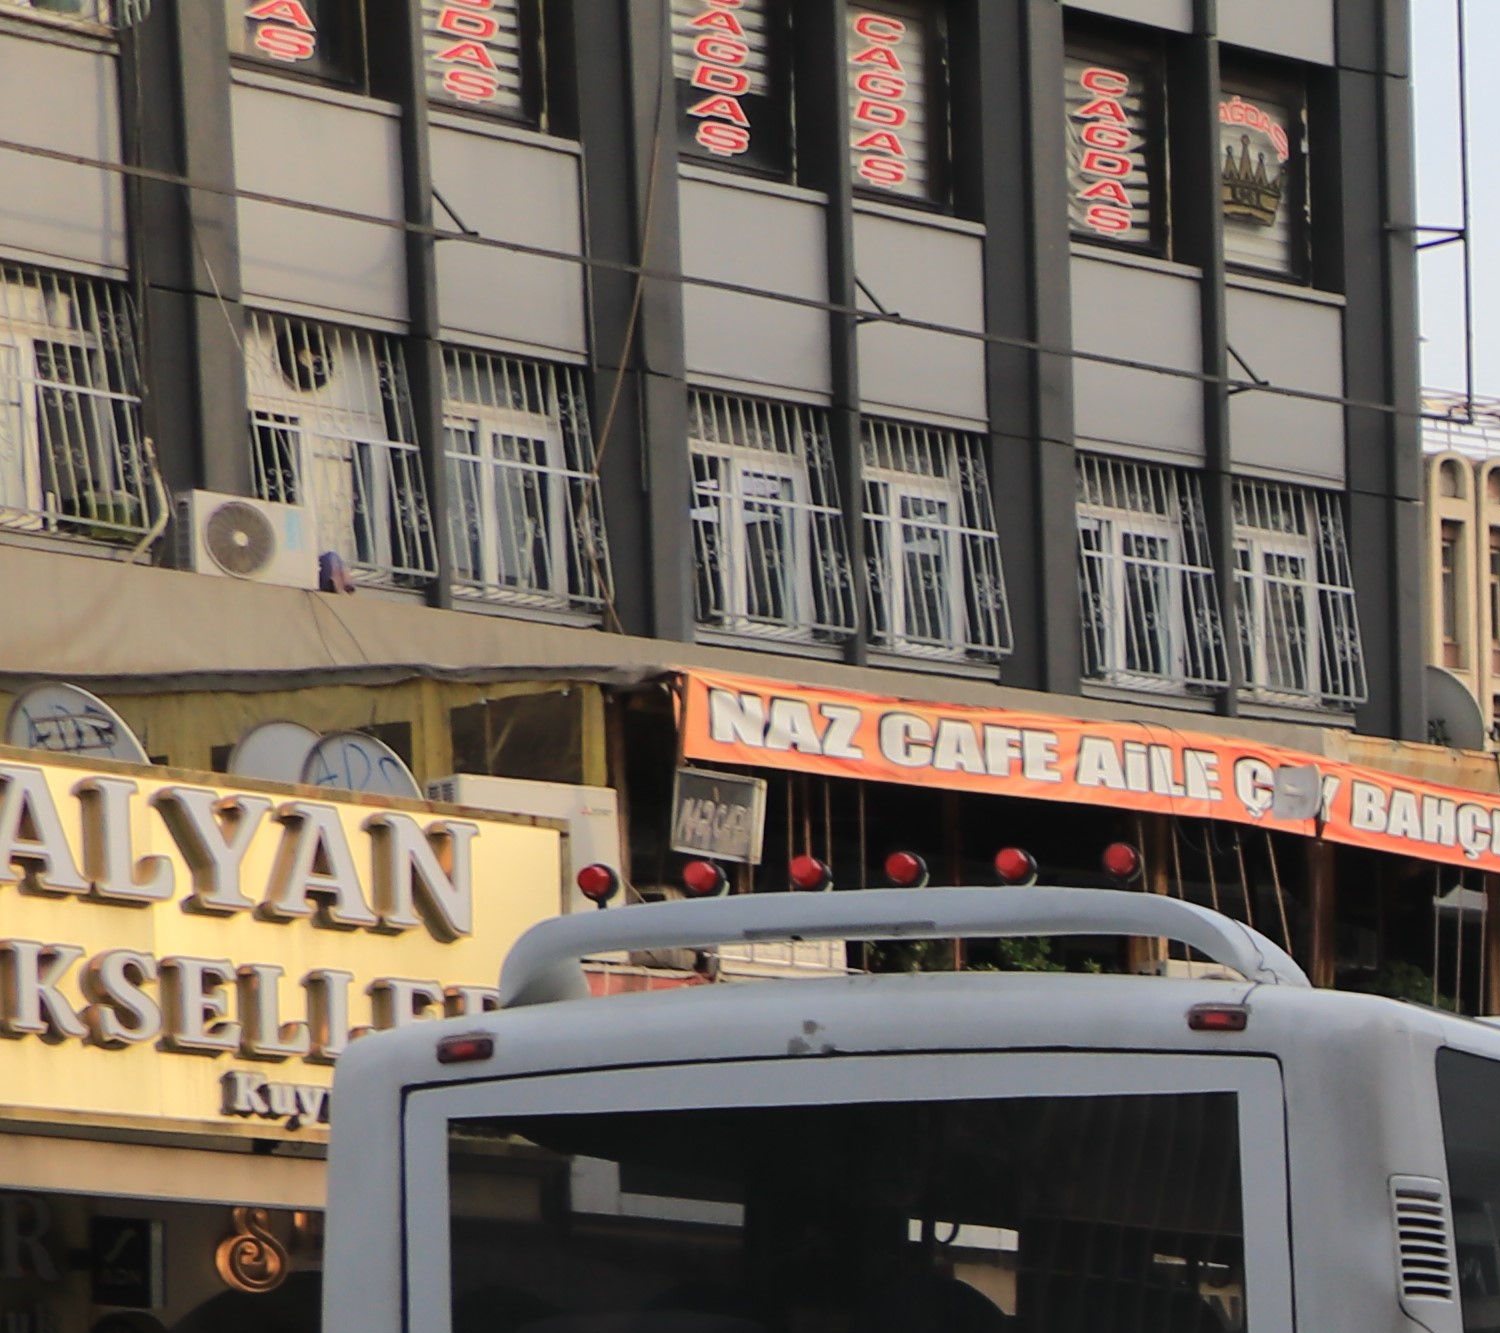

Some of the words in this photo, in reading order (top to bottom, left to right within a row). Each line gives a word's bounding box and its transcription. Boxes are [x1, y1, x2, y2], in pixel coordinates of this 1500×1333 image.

[686, 0, 751, 156] AĞDAŞ
[709, 688, 864, 760] NAZ
[878, 711, 1062, 783] CAFE
[1234, 757, 1343, 823] ÇY
[234, 1070, 333, 1127] Kuy
